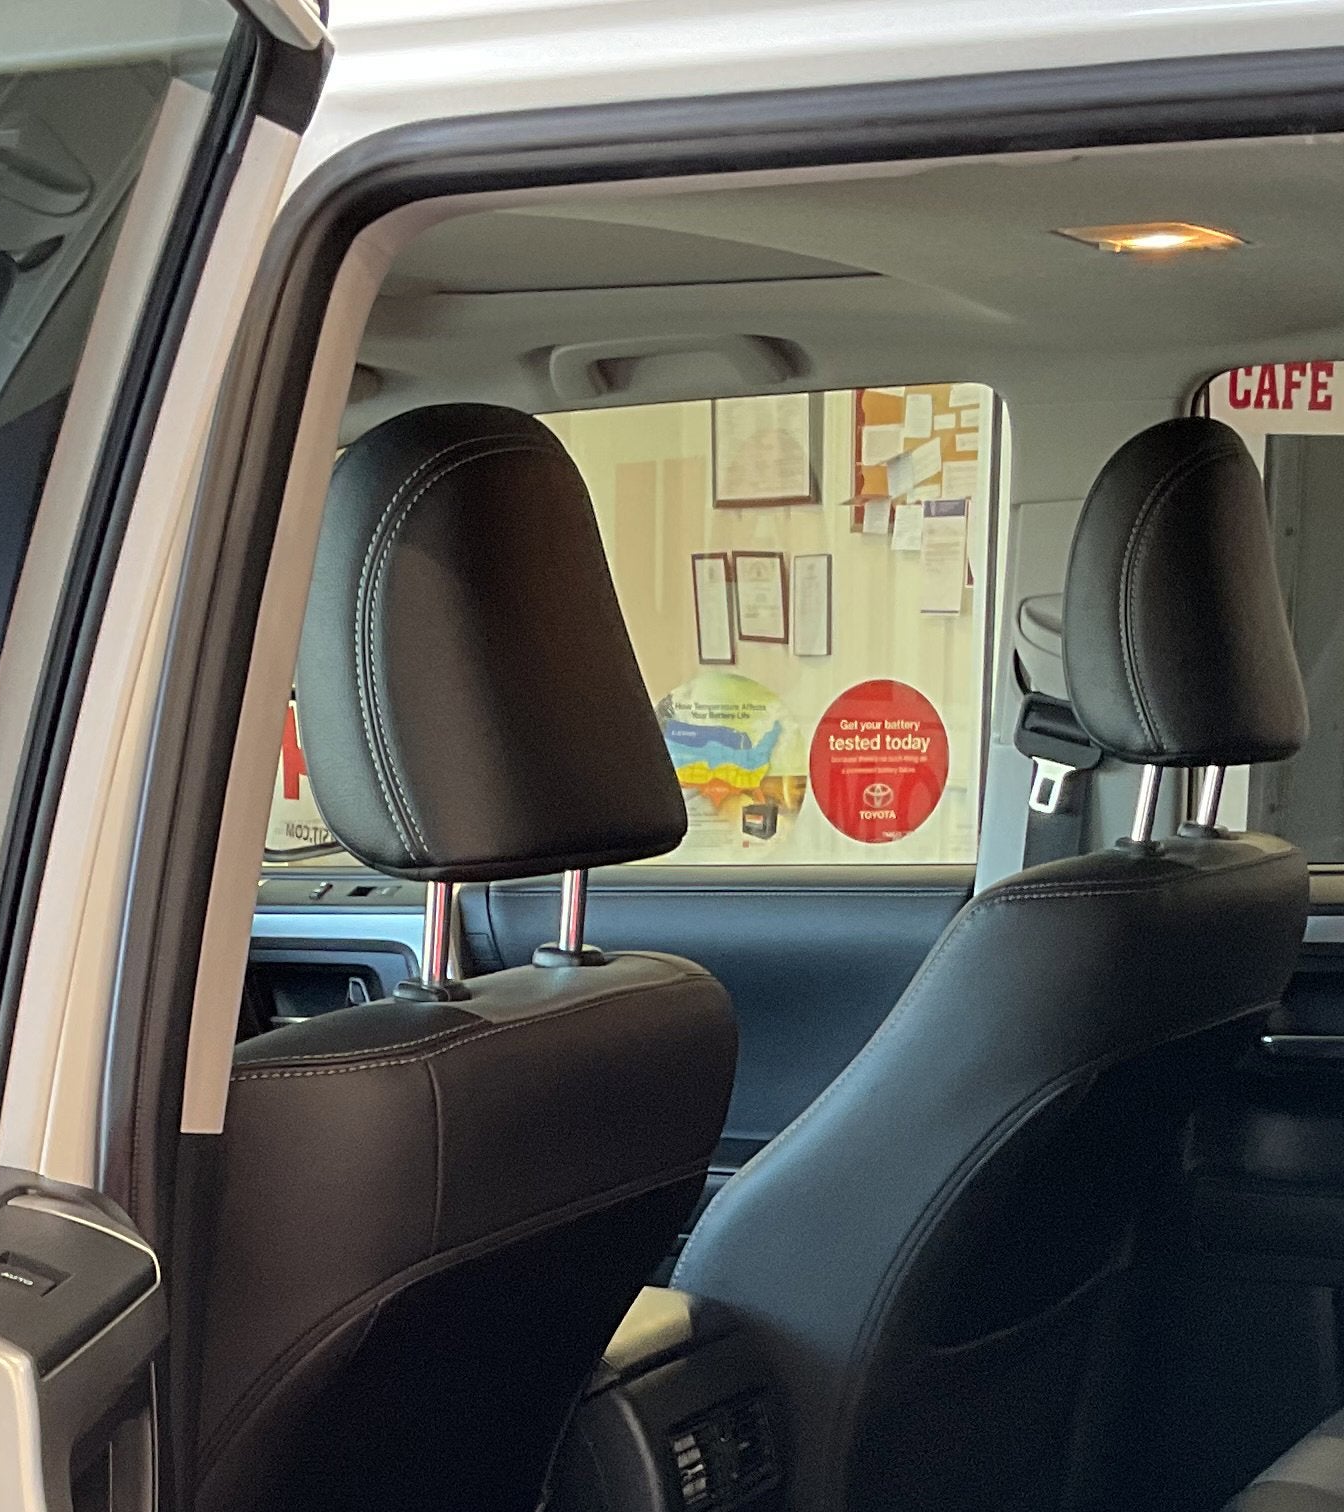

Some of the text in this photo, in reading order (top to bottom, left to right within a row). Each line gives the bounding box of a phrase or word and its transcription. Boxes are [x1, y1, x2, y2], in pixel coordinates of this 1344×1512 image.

[1228, 361, 1334, 411] CAFE
[840, 720, 920, 732] Get your battery
[829, 734, 931, 753] tested today
[859, 810, 897, 820] TOYOTA
[0, 1272, 34, 1286] AUTO
